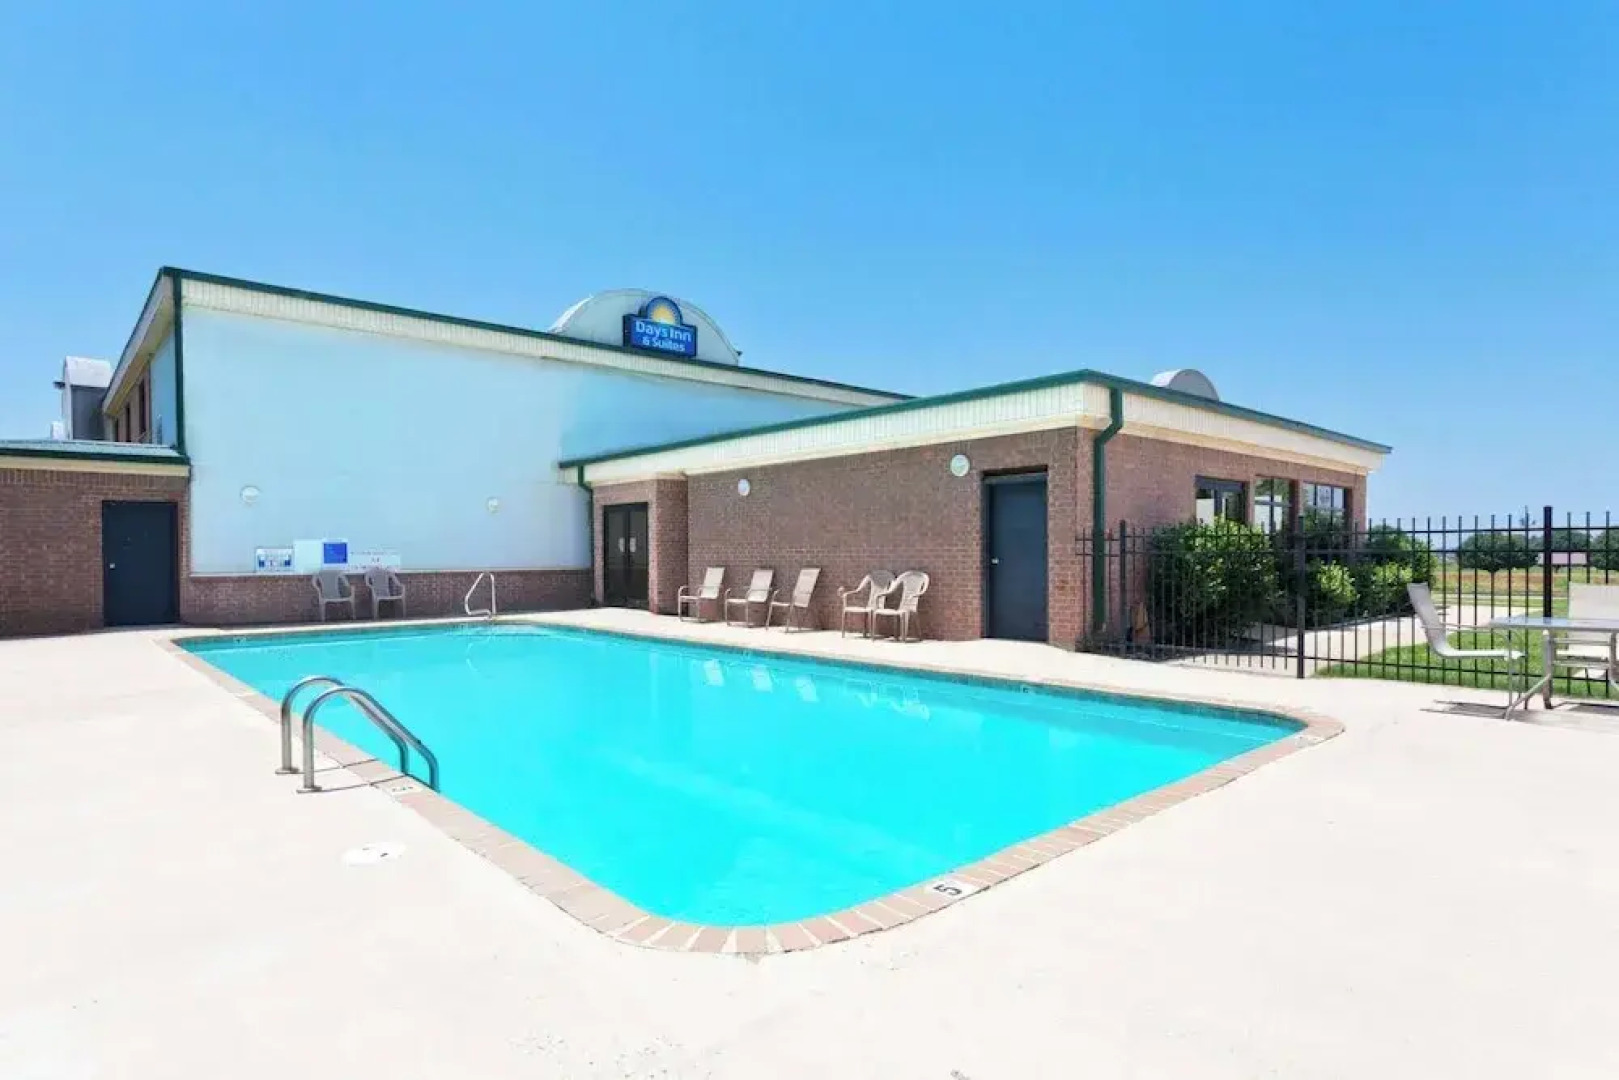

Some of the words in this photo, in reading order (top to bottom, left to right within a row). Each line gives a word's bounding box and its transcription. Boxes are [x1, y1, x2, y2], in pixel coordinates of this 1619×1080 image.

[635, 321, 668, 338] Days
[669, 327, 692, 343] Inn
[652, 336, 686, 352] Suites
[933, 883, 962, 896] 5
